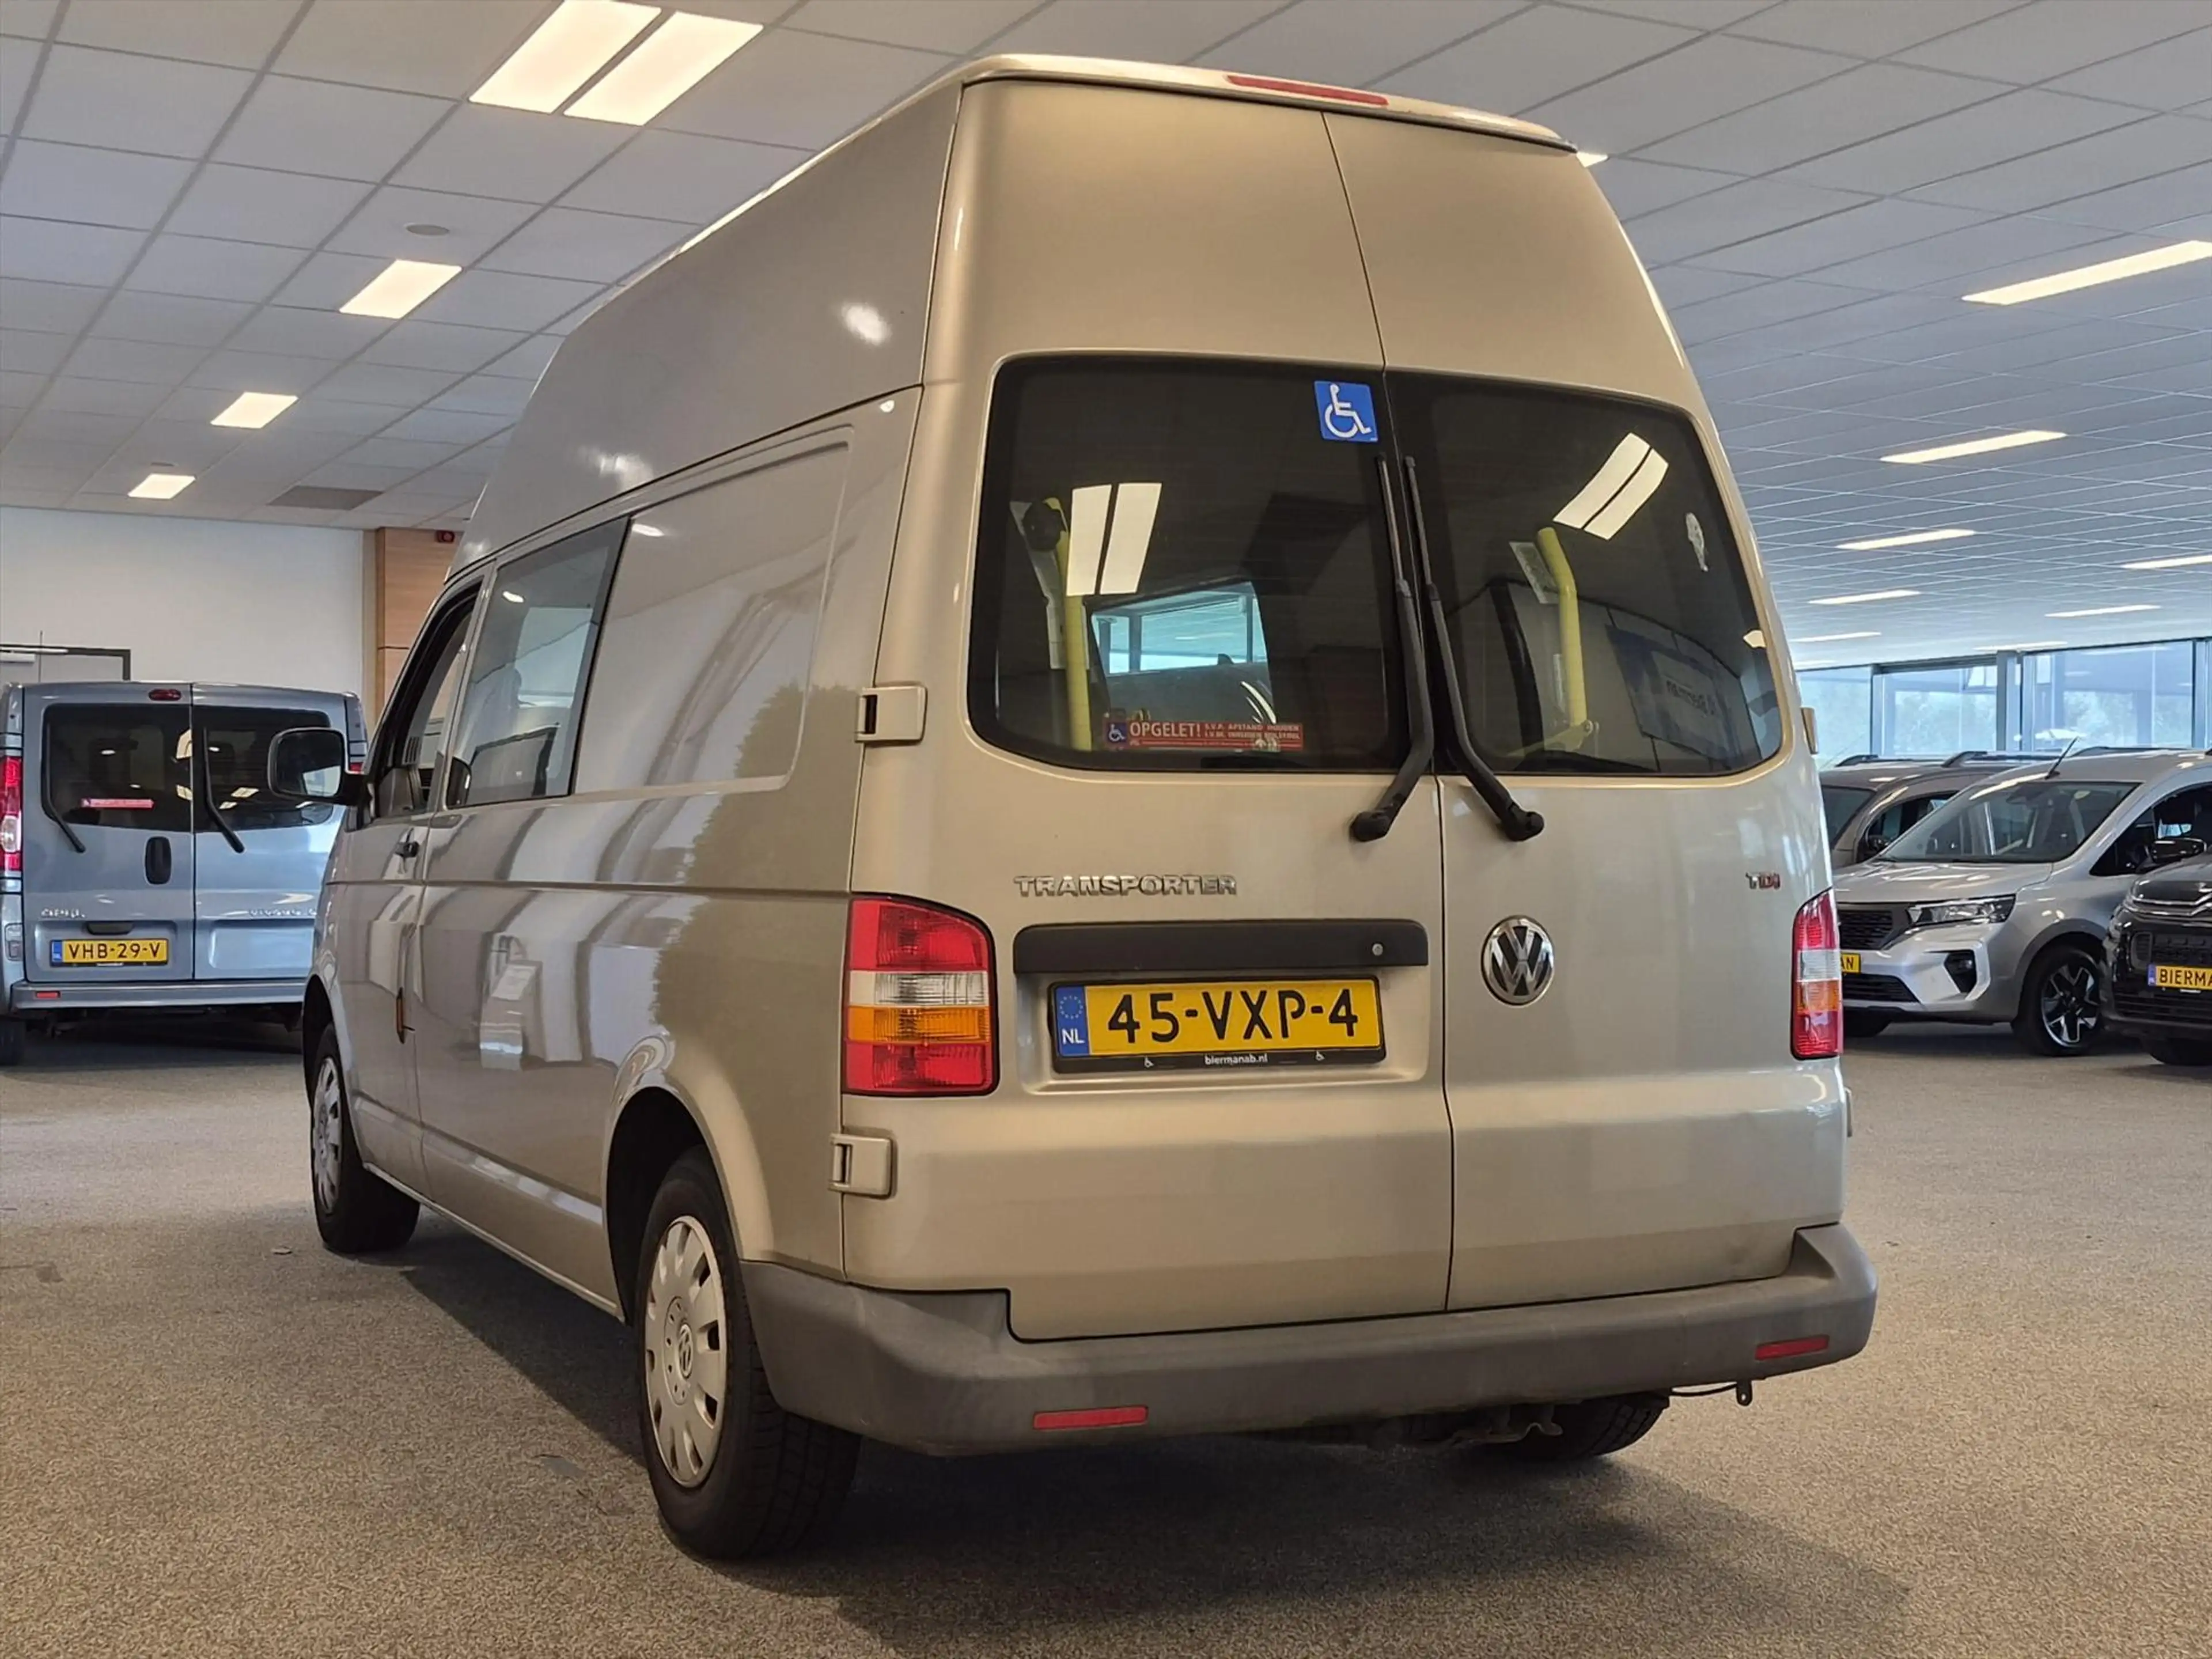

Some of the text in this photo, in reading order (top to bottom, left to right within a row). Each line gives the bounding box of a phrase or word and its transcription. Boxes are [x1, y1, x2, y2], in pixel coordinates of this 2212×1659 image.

[1130, 721, 1201, 737] OPGELET!
[1014, 875, 1237, 897] TRANSPORTER
[67, 942, 161, 959] VHB-29-V
[1107, 988, 1358, 1043] 45-VXP-4
[1062, 1029, 1084, 1044] NL
[1205, 1053, 1268, 1066] biermanab.nl
